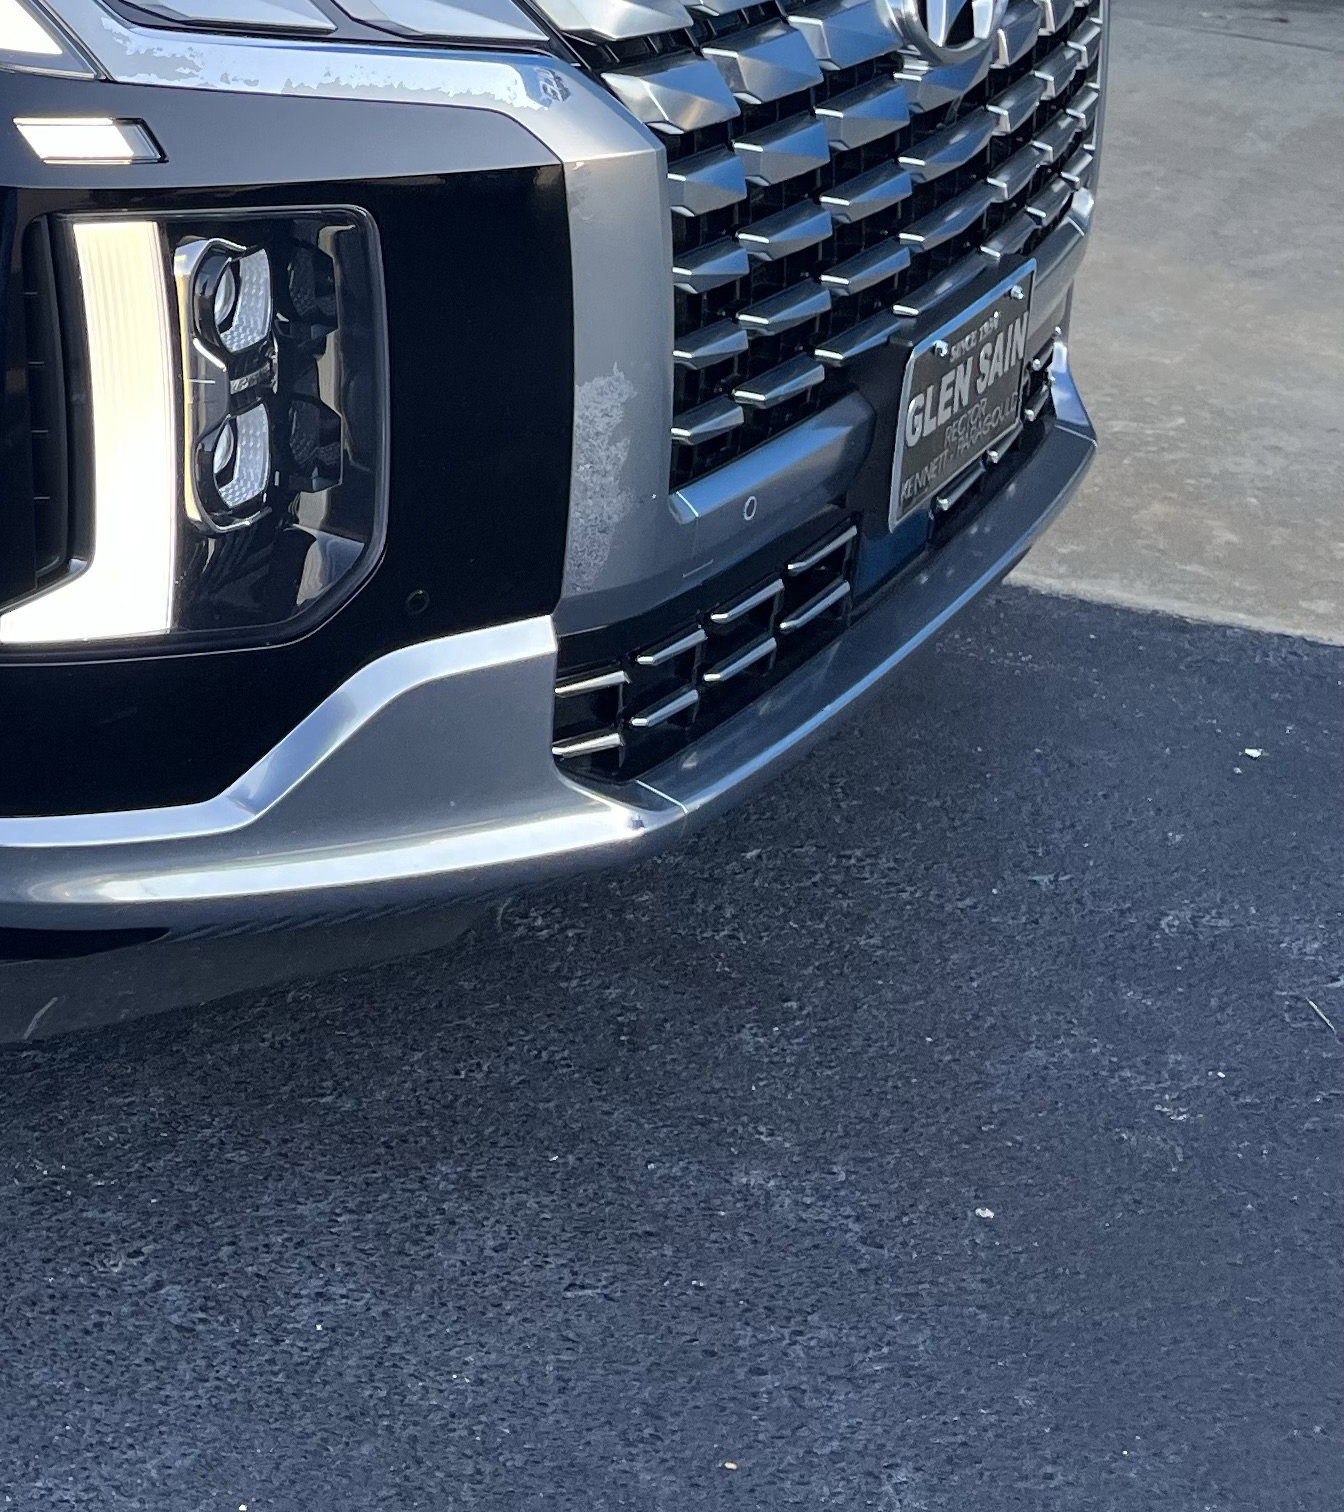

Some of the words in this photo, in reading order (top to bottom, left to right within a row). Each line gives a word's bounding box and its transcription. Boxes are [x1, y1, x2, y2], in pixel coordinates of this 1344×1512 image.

[905, 356, 973, 448] GLEN
[976, 311, 1029, 394] SAIN
[944, 397, 988, 450] RECTOR
[900, 448, 950, 502] KENNETT
